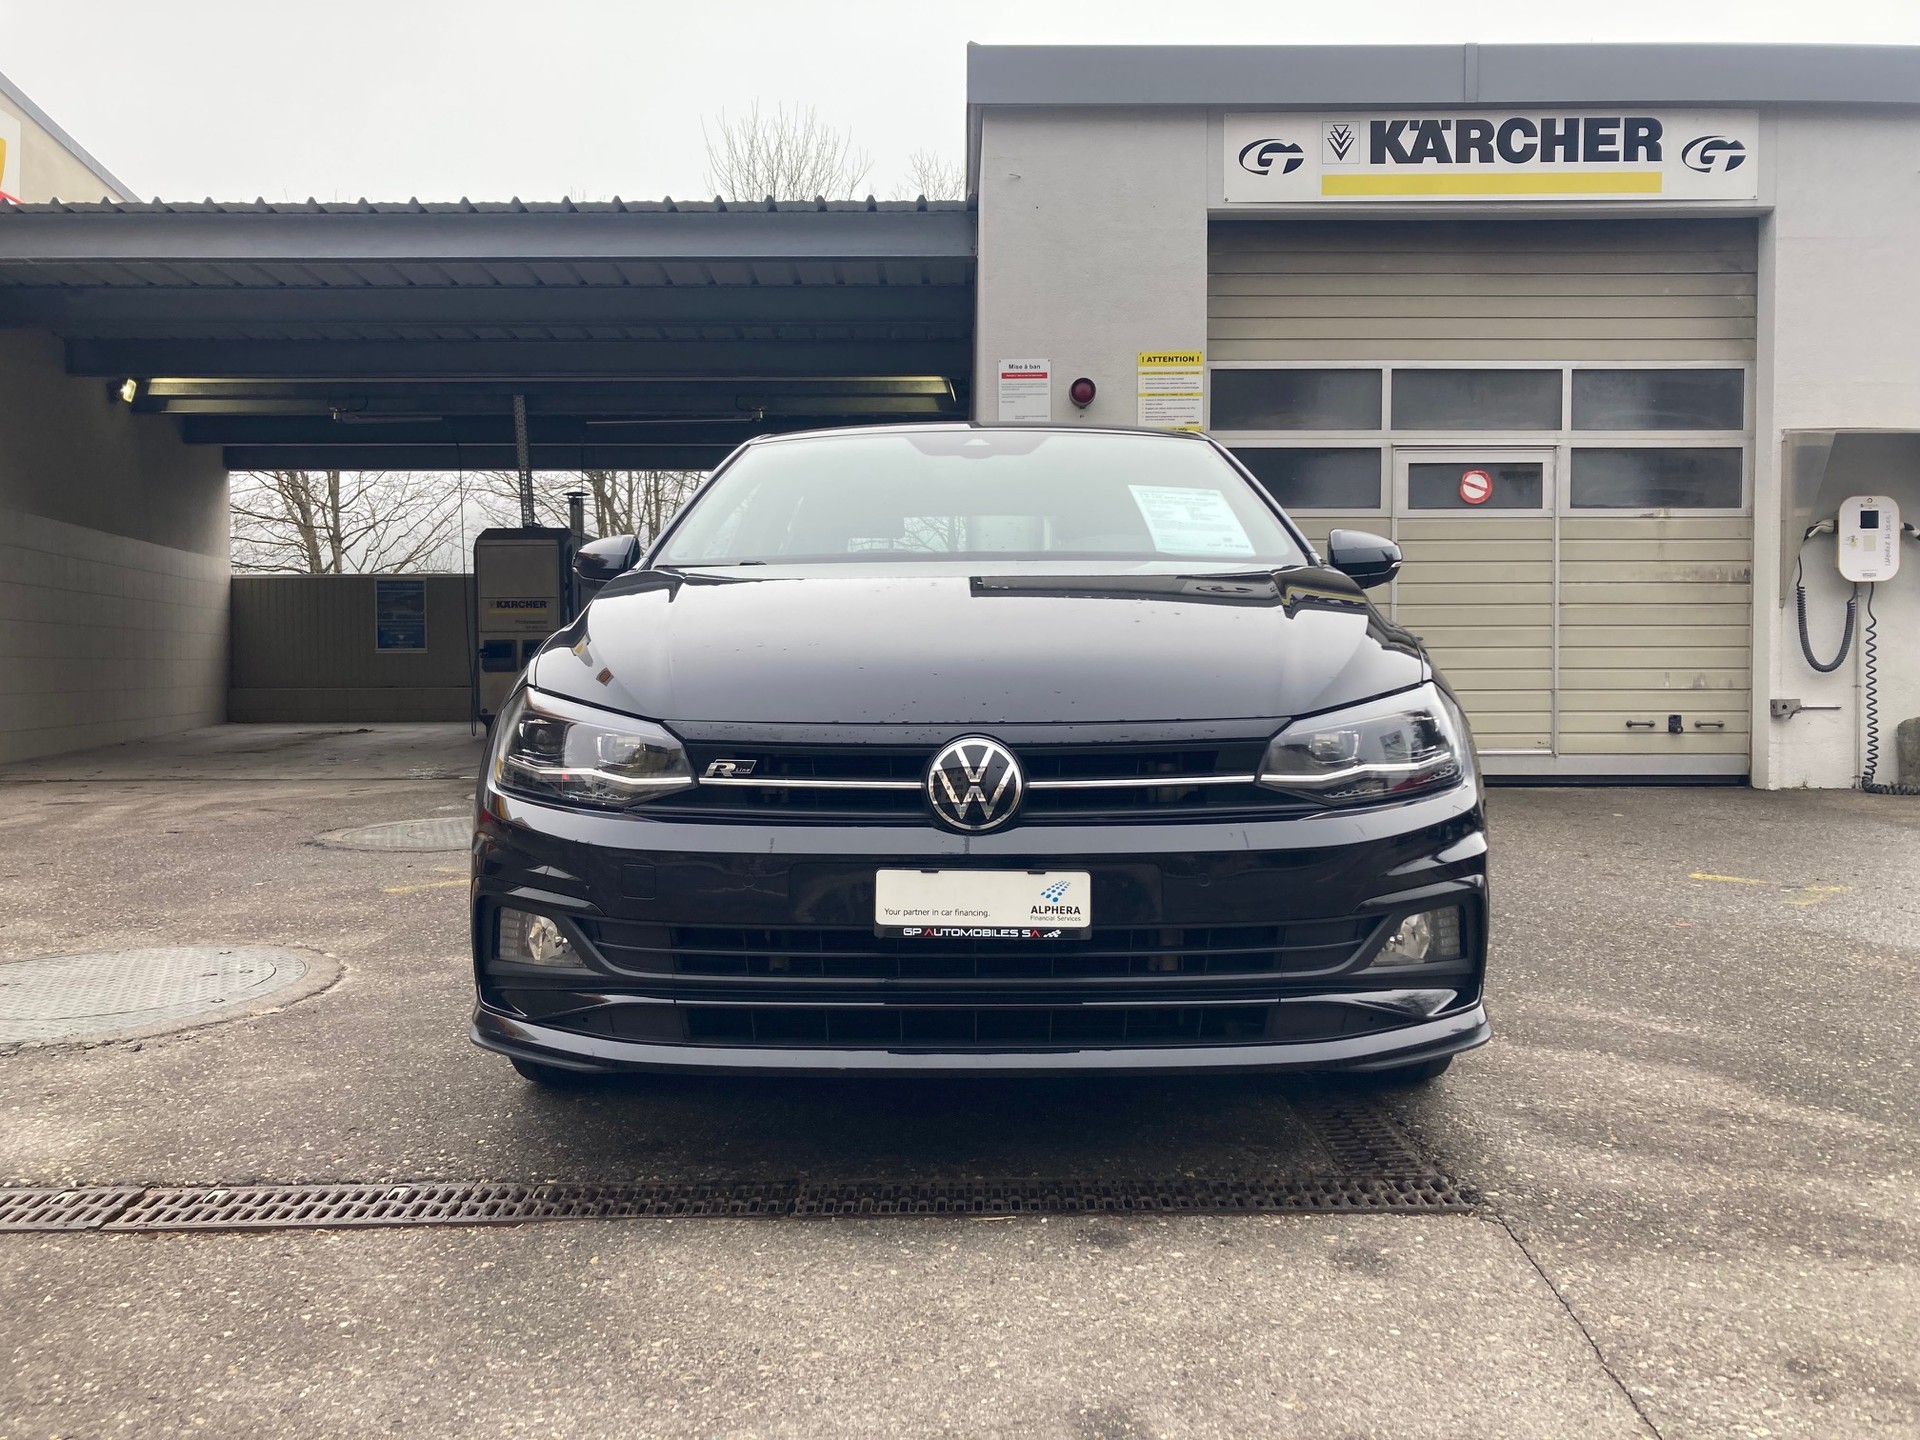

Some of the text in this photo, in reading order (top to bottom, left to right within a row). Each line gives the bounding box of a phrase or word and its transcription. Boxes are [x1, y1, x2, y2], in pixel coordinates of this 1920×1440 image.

[1370, 116, 1663, 165] KÄRCHER
[1146, 355, 1195, 363] ATTENTION
[496, 600, 547, 609] KÄRCHER
[704, 762, 736, 777] R
[884, 907, 991, 918] Your partner in car financing.
[1030, 905, 1081, 915] ALPHERA
[903, 928, 1041, 938] GP AUTOMOBILES SA
